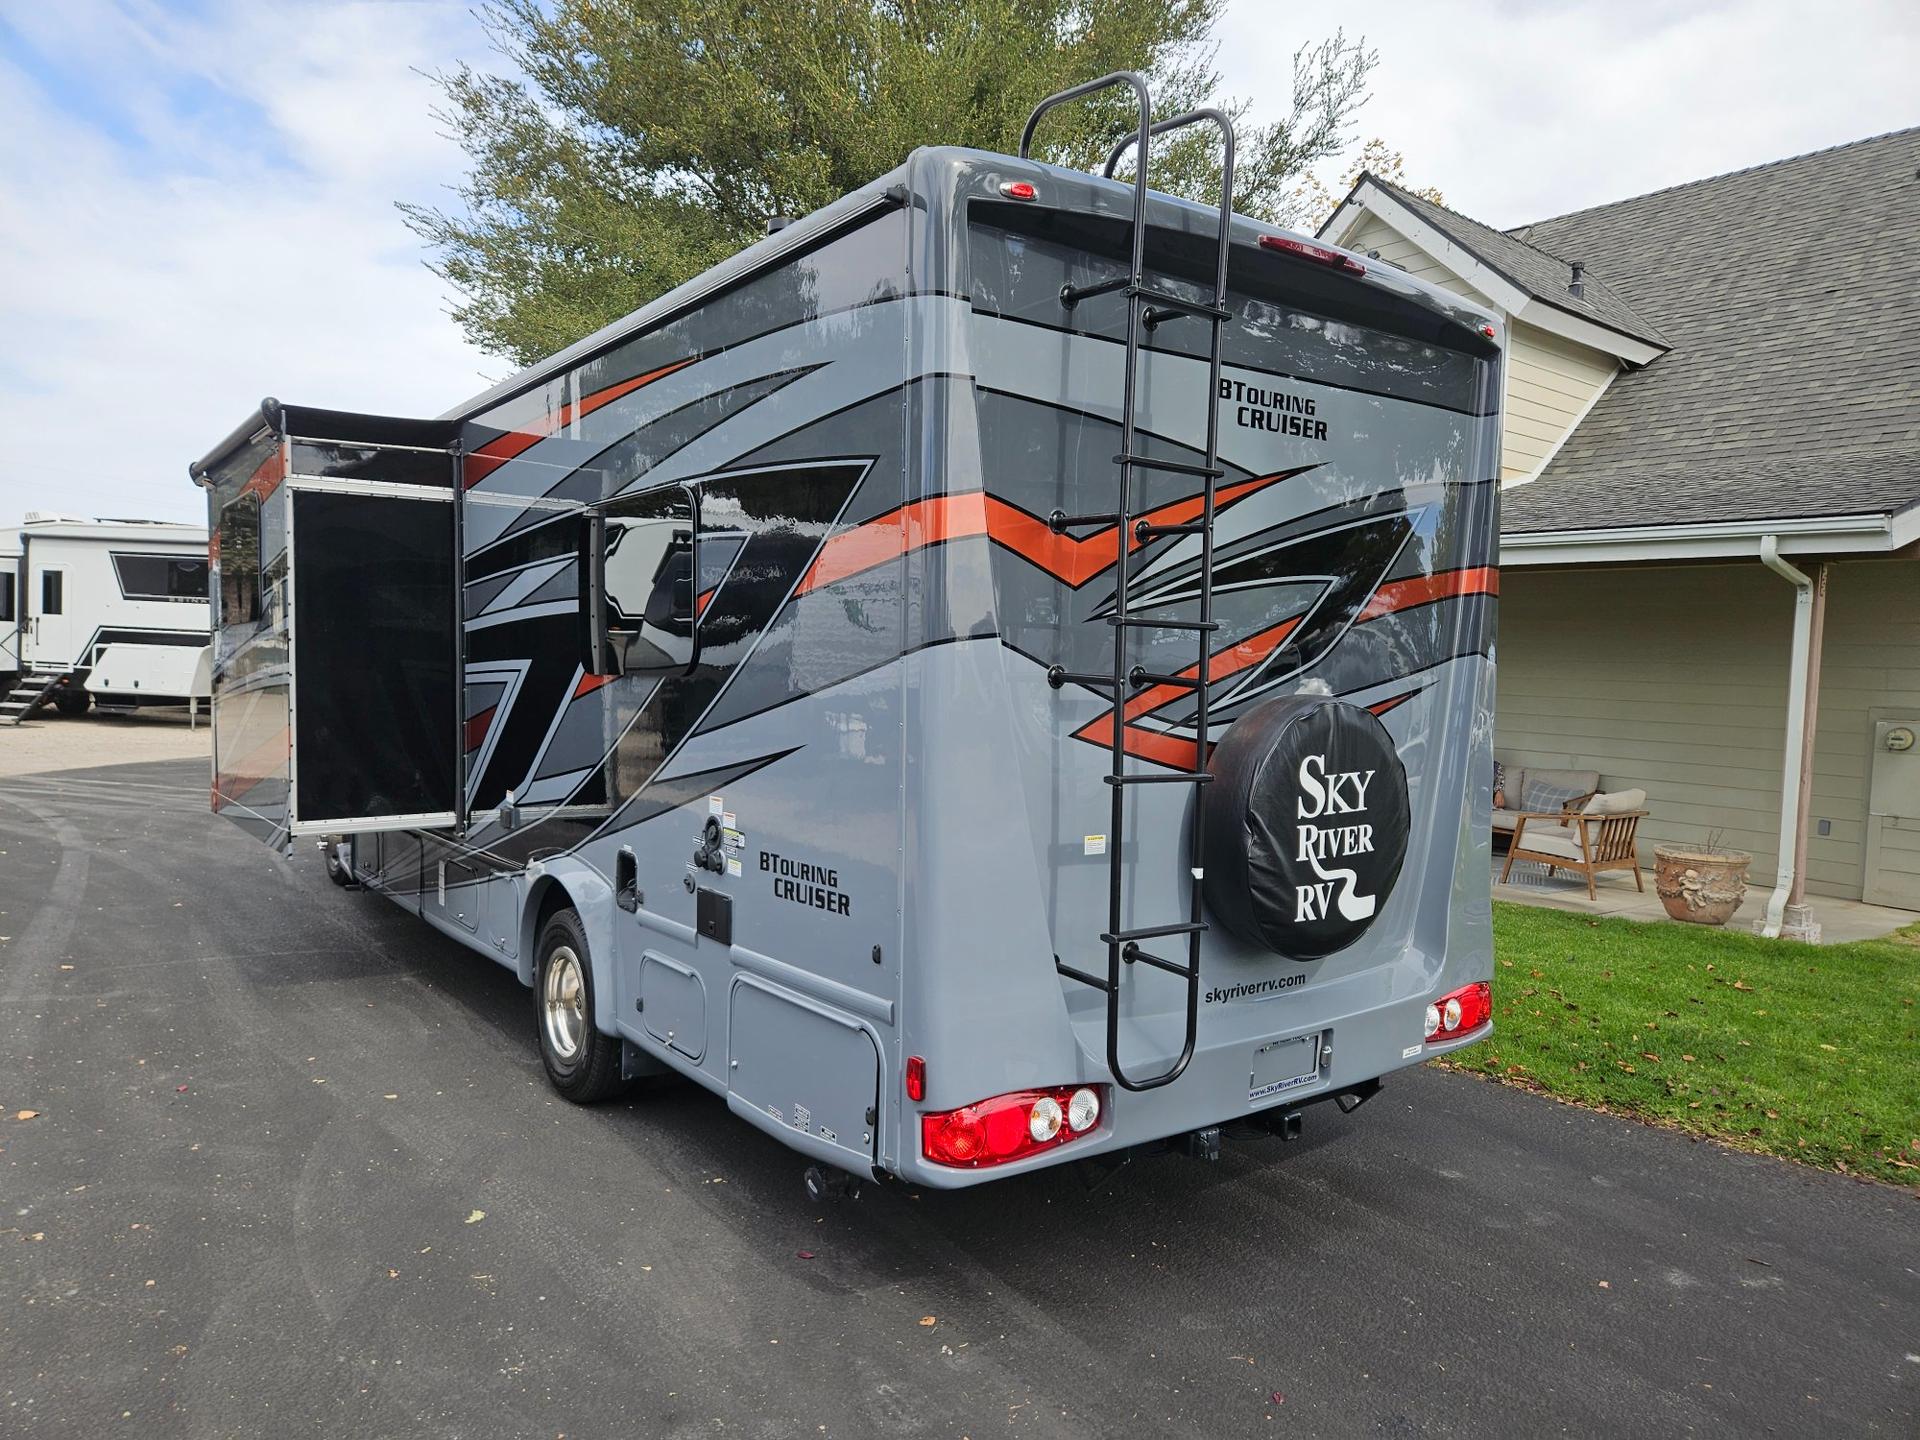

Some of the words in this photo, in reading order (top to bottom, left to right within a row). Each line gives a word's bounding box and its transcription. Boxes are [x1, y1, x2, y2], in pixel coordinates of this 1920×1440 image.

[1237, 406, 1328, 441] CRUISER
[1298, 754, 1376, 820] SKY
[1296, 824, 1375, 862] RIVER
[759, 850, 838, 888] BTOURING
[774, 877, 851, 917] CRUISER
[1294, 882, 1335, 922] RV
[1205, 974, 1306, 1004] skyriverrv.com
[1248, 1074, 1318, 1099] www.SkyRiverRV.com
